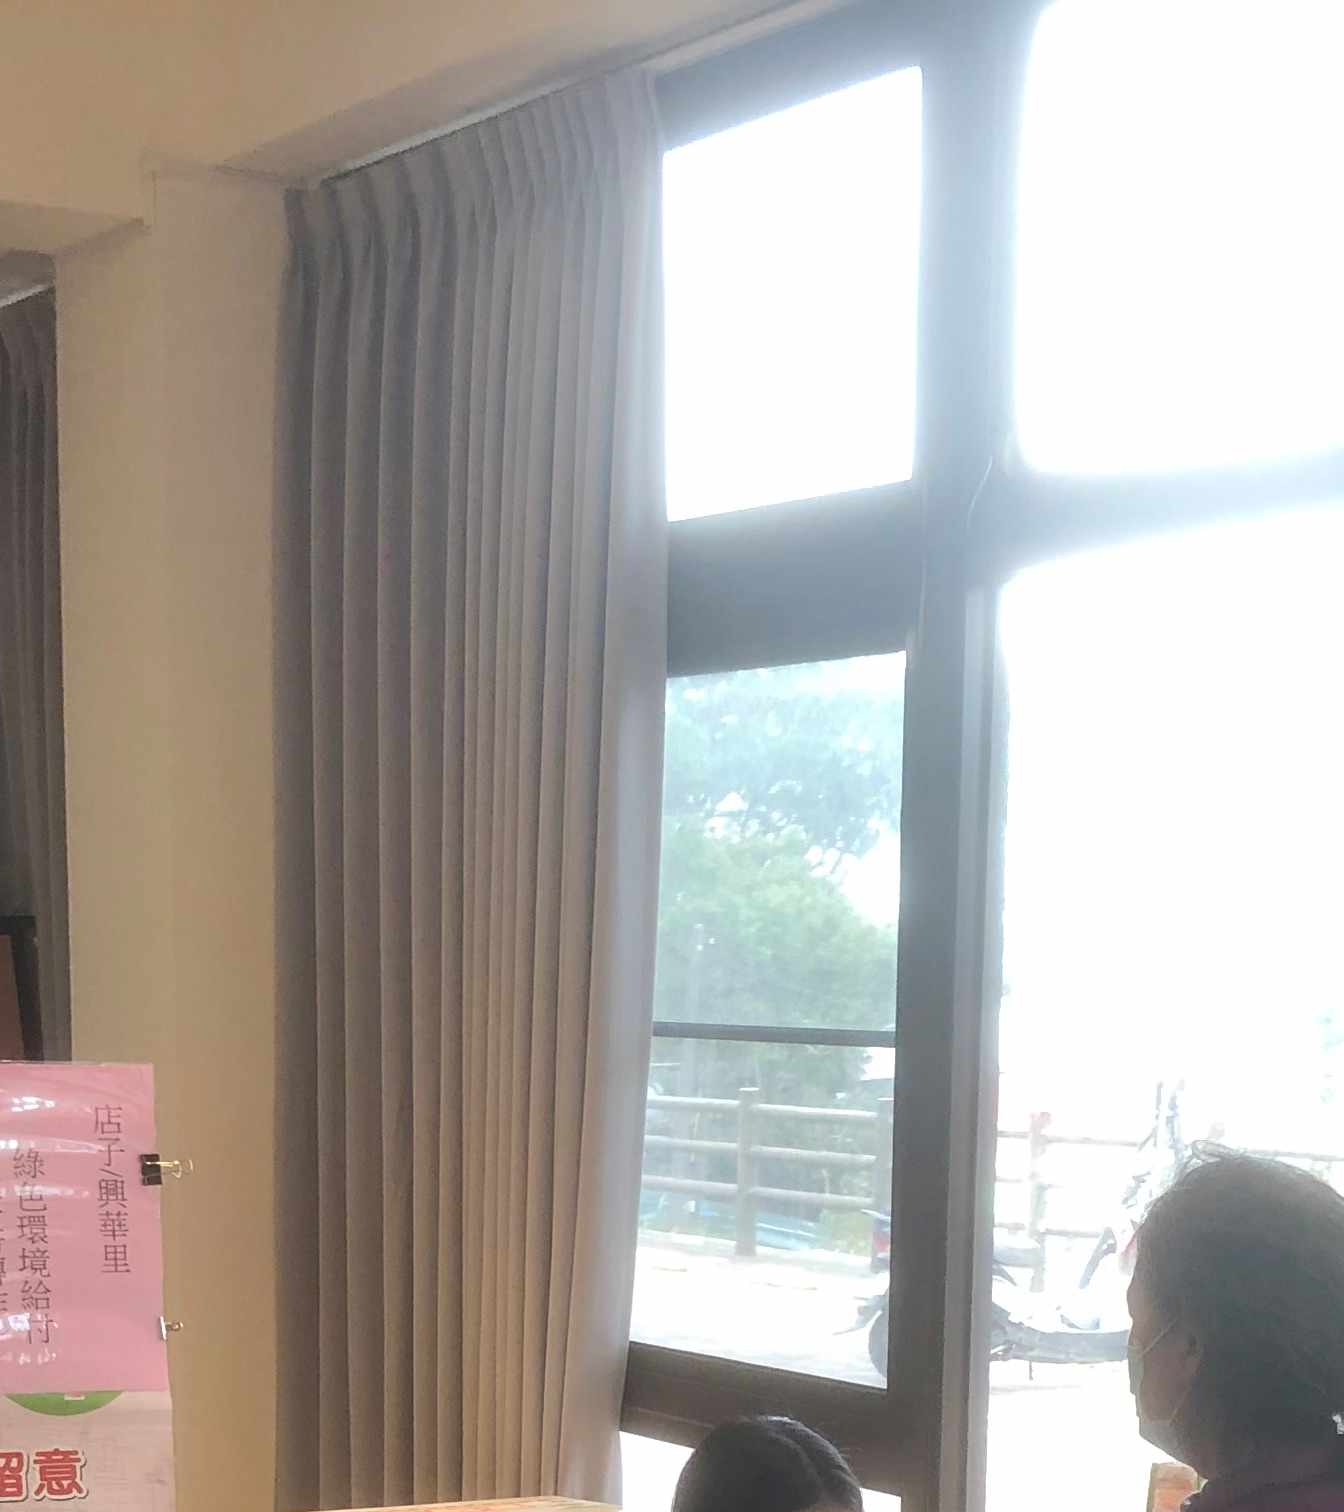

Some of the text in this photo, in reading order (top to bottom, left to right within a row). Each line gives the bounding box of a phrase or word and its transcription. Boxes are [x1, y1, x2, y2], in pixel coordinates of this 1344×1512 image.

[12, 1147, 54, 1345] 綠色環境給付
[93, 1104, 131, 1274] 店子/興華里
